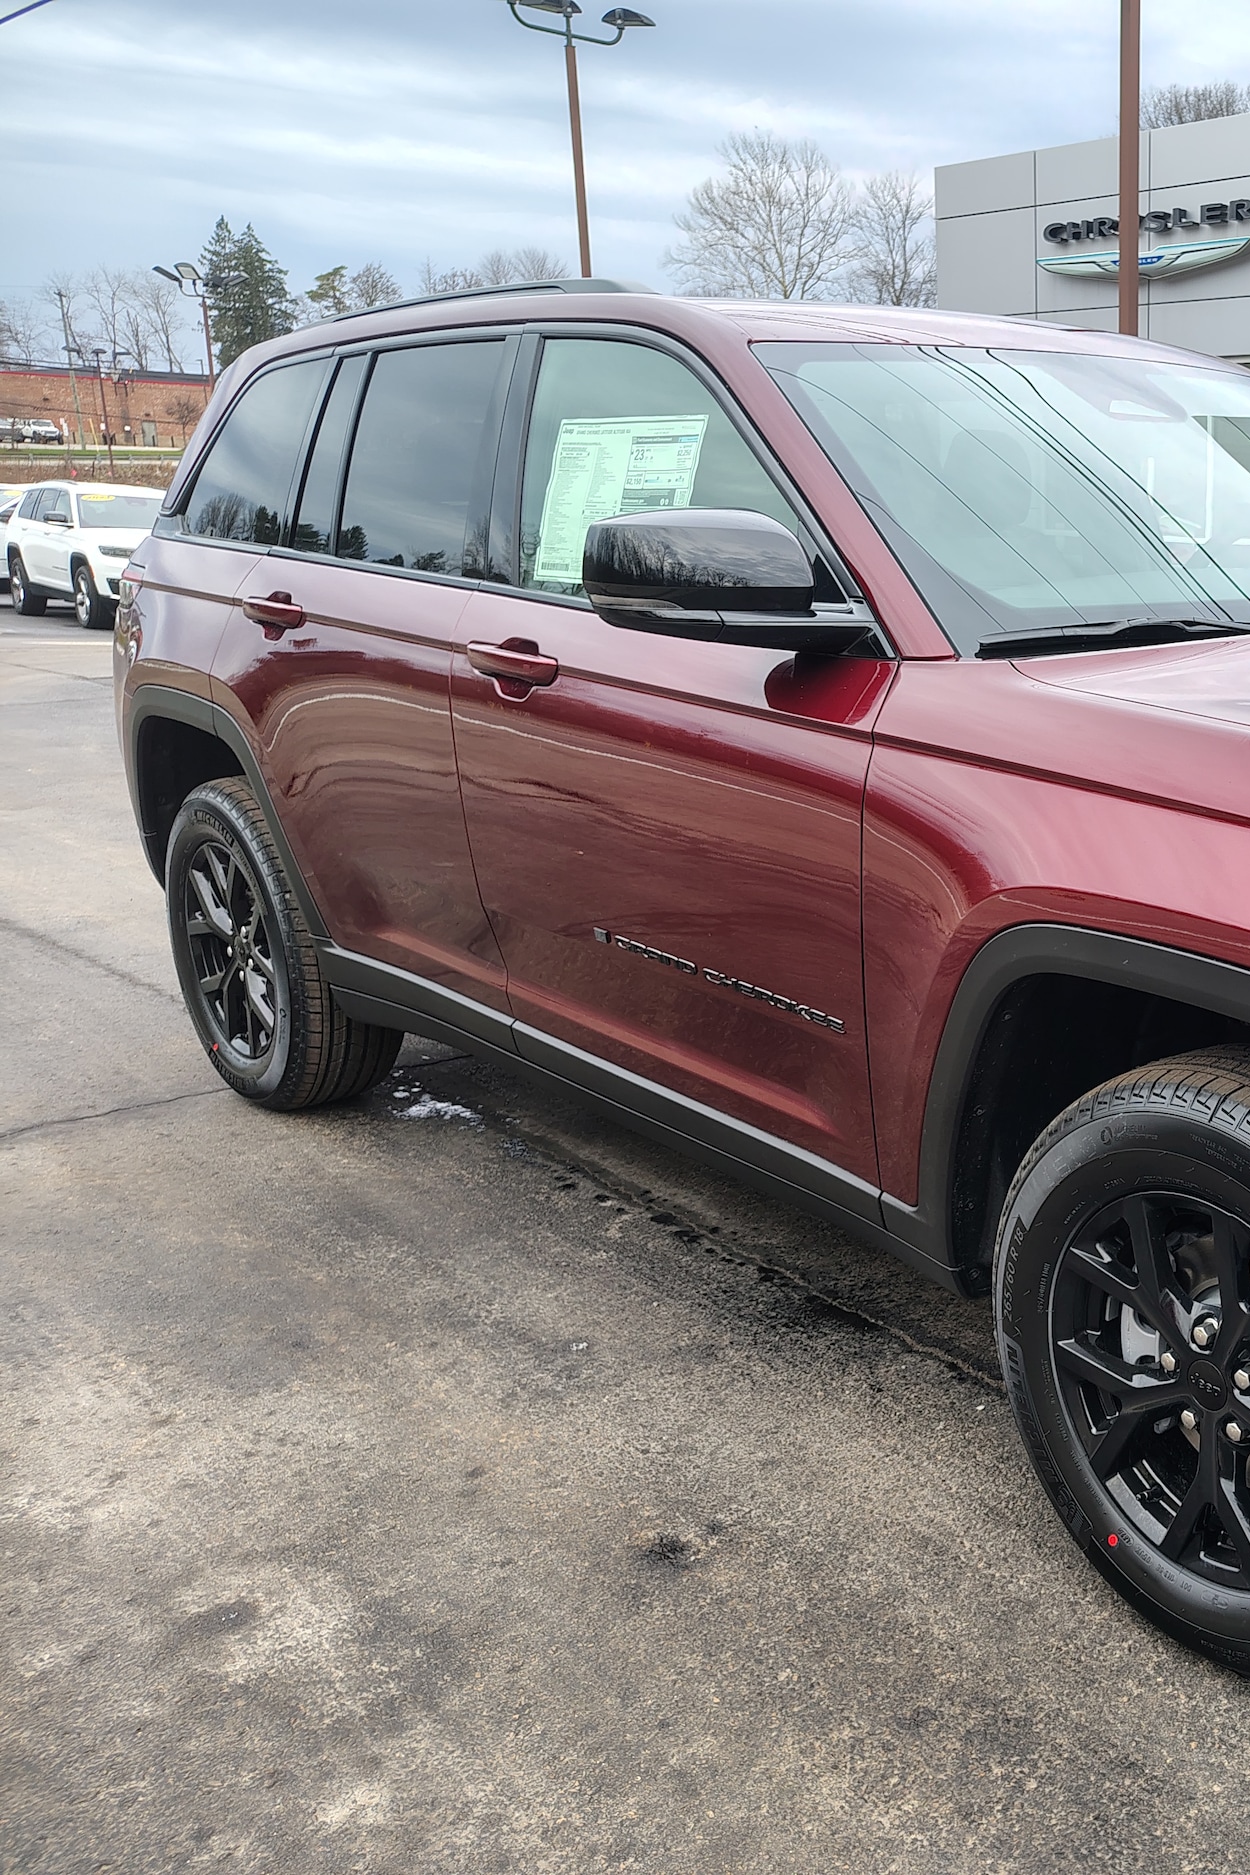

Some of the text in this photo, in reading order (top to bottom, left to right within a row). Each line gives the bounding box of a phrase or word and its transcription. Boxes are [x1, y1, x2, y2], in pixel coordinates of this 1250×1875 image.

[634, 449, 645, 461] 23
[196, 811, 234, 846] MICHELIN
[614, 934, 847, 1035] GRAND CHEROKEE
[1003, 1226, 1027, 1322] 265/60 R 18
[1006, 1342, 1060, 1483] MICHELIN
